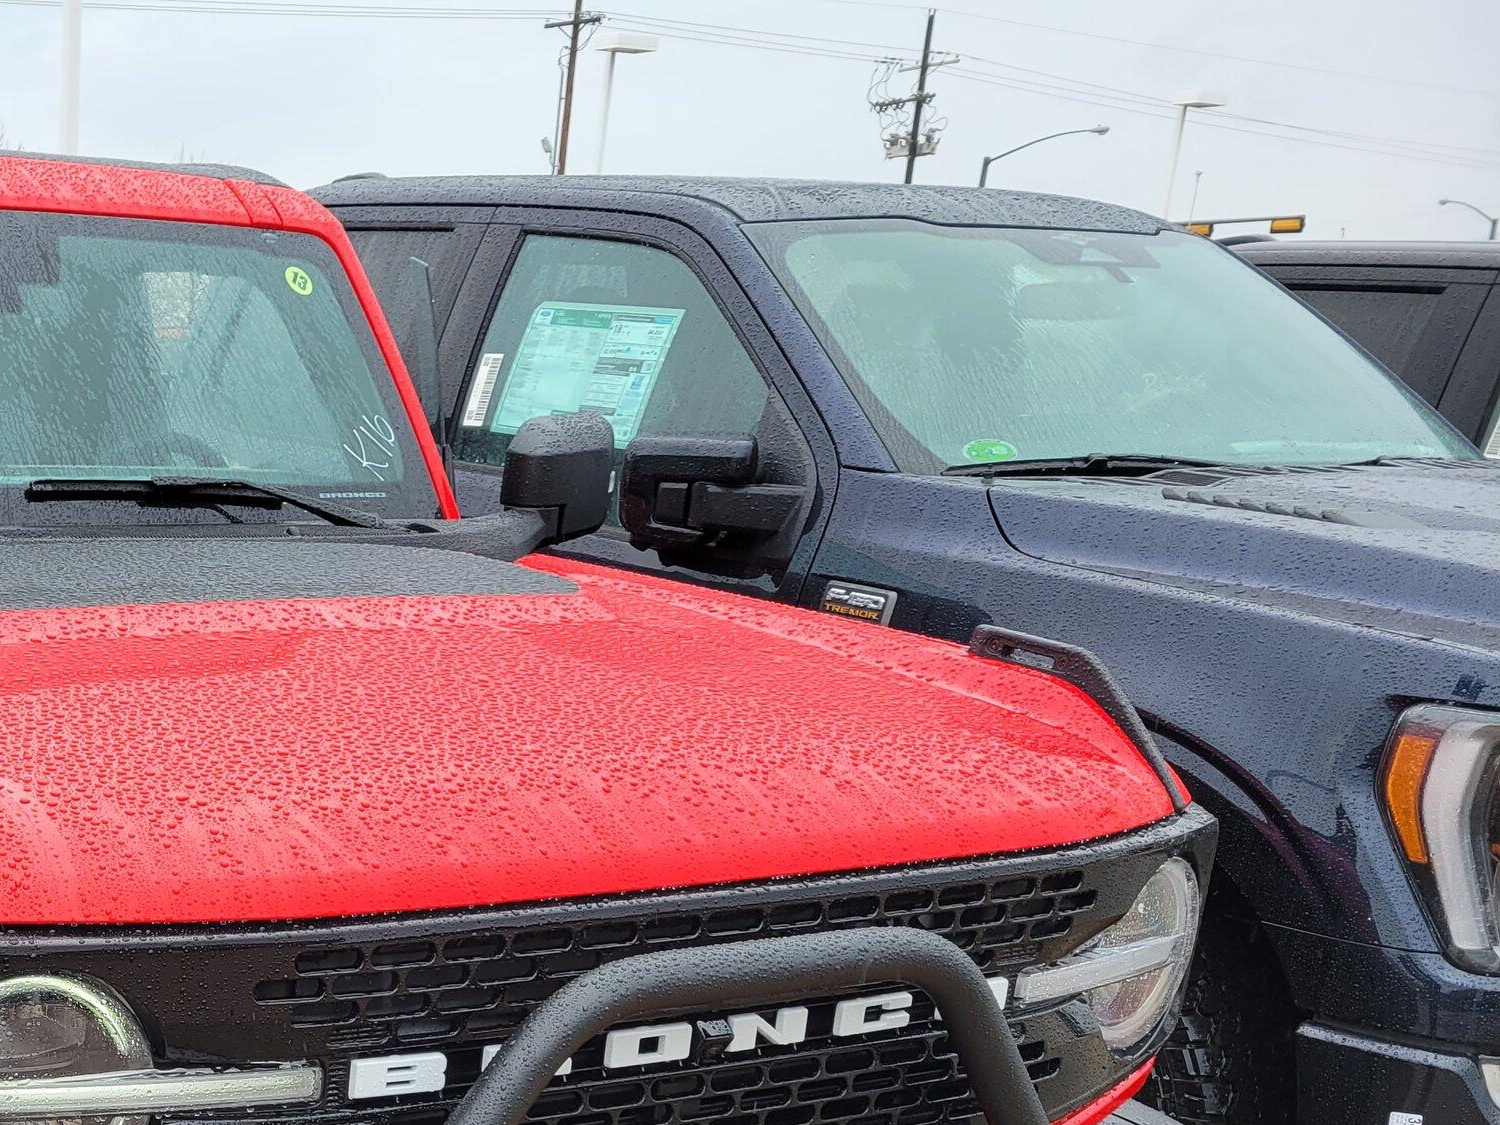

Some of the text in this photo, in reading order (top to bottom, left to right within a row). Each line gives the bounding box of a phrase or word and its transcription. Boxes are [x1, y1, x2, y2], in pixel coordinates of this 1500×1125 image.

[291, 270, 308, 290] 13
[343, 415, 395, 481] K16
[824, 603, 880, 620] TREMOR
[348, 976, 1009, 1101] BONC
